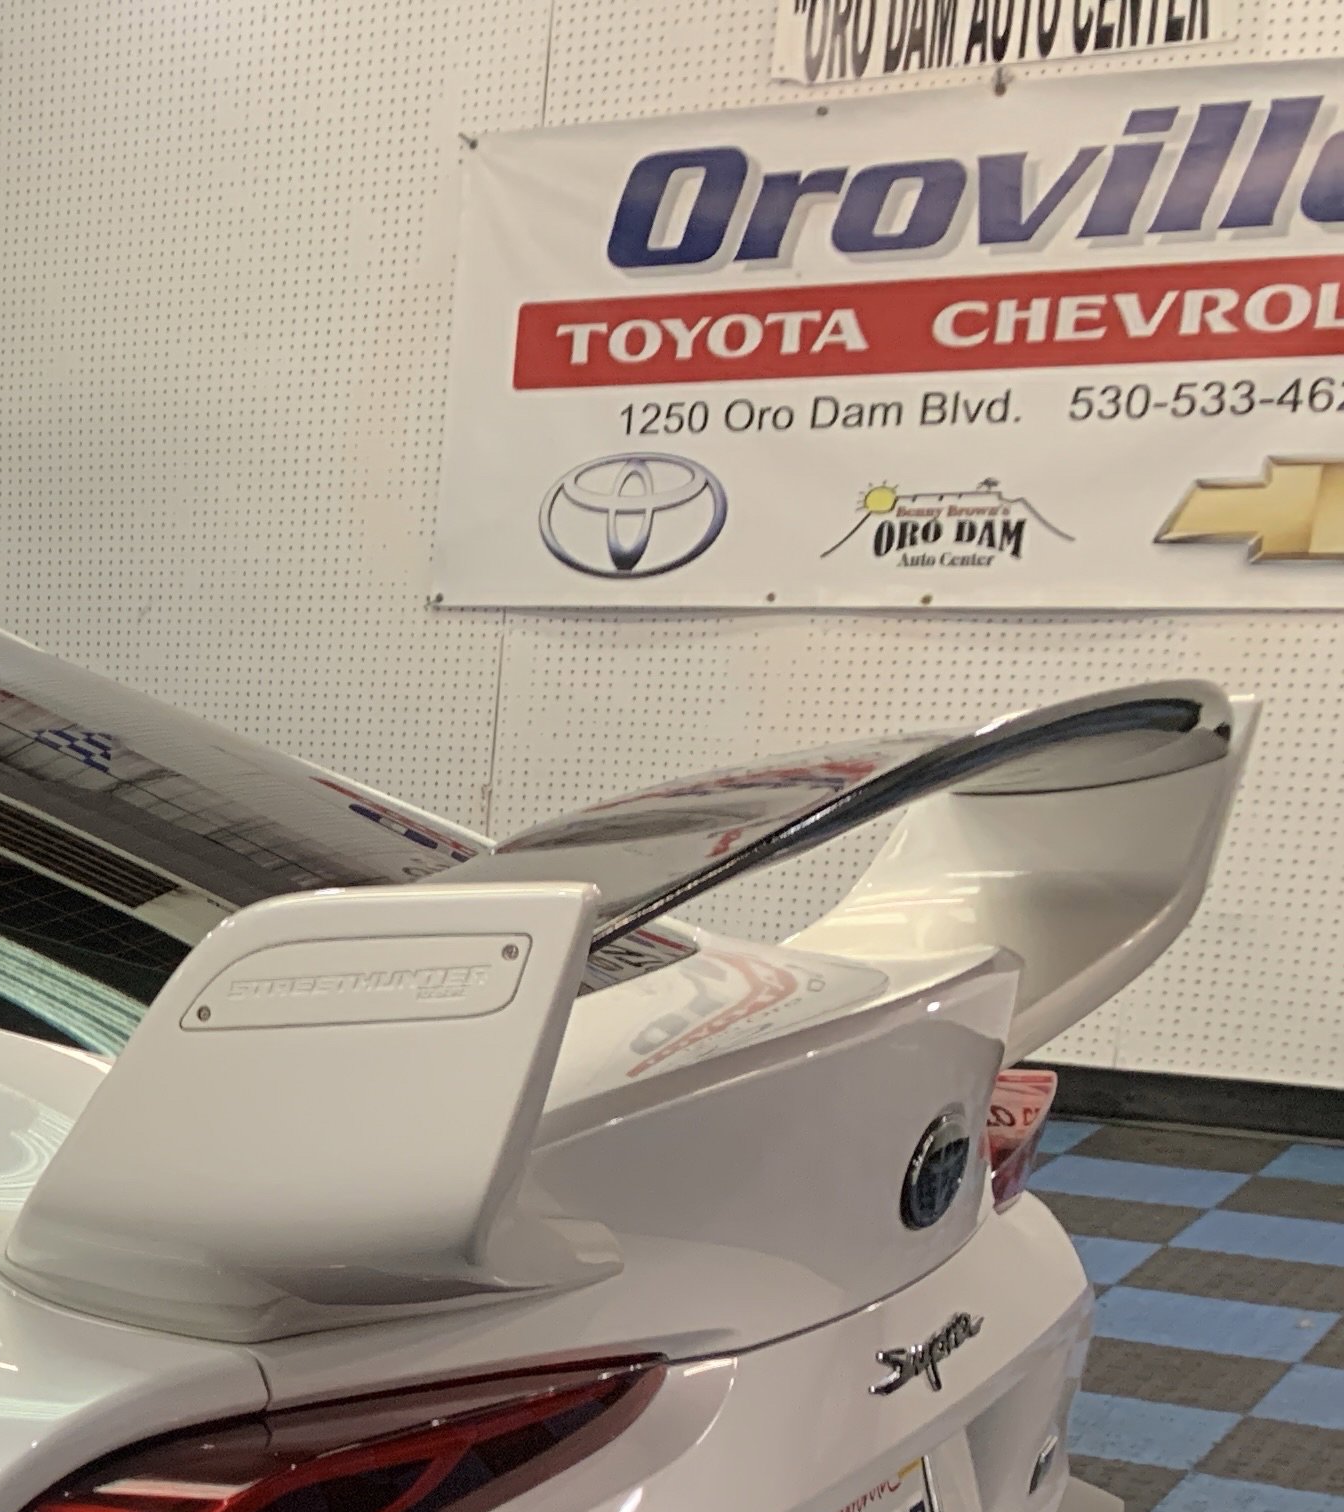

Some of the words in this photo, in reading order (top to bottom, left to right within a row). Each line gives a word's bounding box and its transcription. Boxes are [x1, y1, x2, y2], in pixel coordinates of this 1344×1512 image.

[882, 0, 958, 74] DAM
[557, 308, 869, 367] TOYOTA
[619, 402, 710, 436] 1250
[723, 400, 795, 433] Oro
[810, 394, 904, 430] Dam
[919, 388, 1023, 426] Blvd.
[1068, 376, 1344, 423] 530-533-46
[874, 519, 943, 558] ORO
[954, 518, 1026, 559] DAM
[896, 553, 936, 568] Auto
[940, 552, 995, 567] Center
[868, 1311, 984, 1394] Supra
